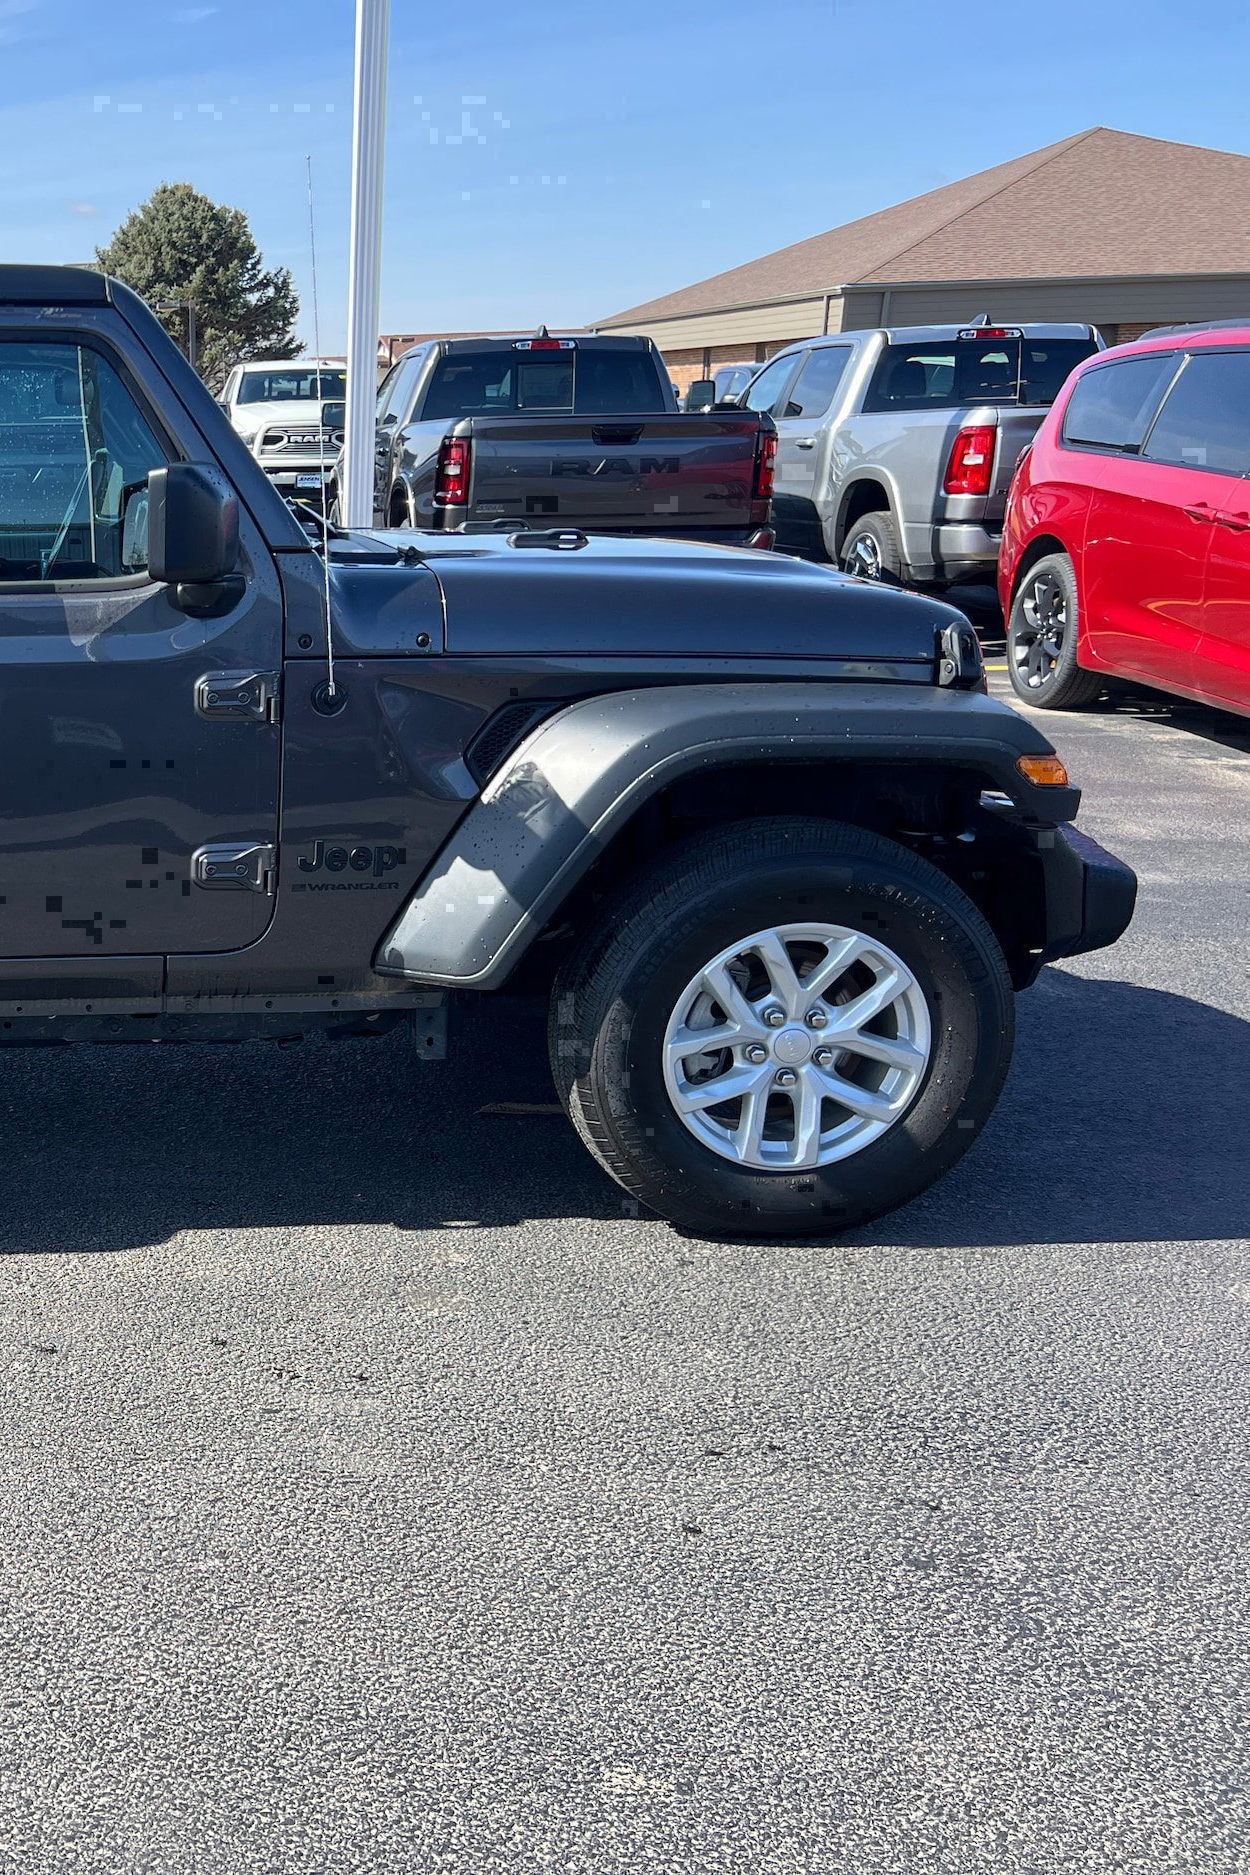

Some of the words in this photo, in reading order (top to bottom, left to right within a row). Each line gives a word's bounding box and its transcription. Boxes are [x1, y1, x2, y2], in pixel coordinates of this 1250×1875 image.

[290, 435, 329, 443] RAM
[552, 457, 680, 475] RAM
[297, 840, 399, 877] Jeep
[307, 882, 399, 892] WRANGLER
